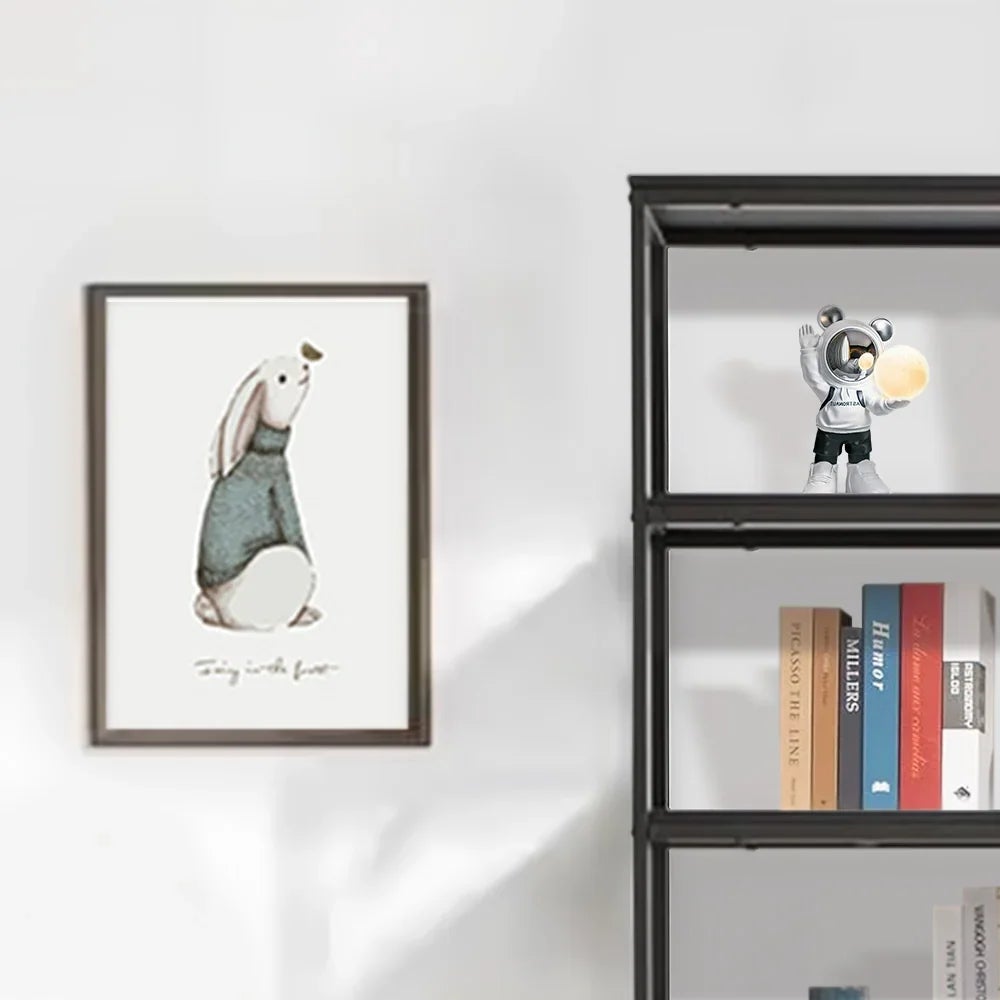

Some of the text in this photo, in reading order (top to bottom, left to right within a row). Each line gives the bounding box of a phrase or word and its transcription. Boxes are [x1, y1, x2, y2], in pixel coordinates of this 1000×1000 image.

[789, 622, 802, 686] PICASSO
[871, 620, 890, 692] Humor
[845, 638, 860, 713] MILLERS
[789, 691, 801, 722] THE
[788, 730, 800, 766] LINE
[945, 940, 956, 968] TIAN
[946, 973, 957, 998] LAN
